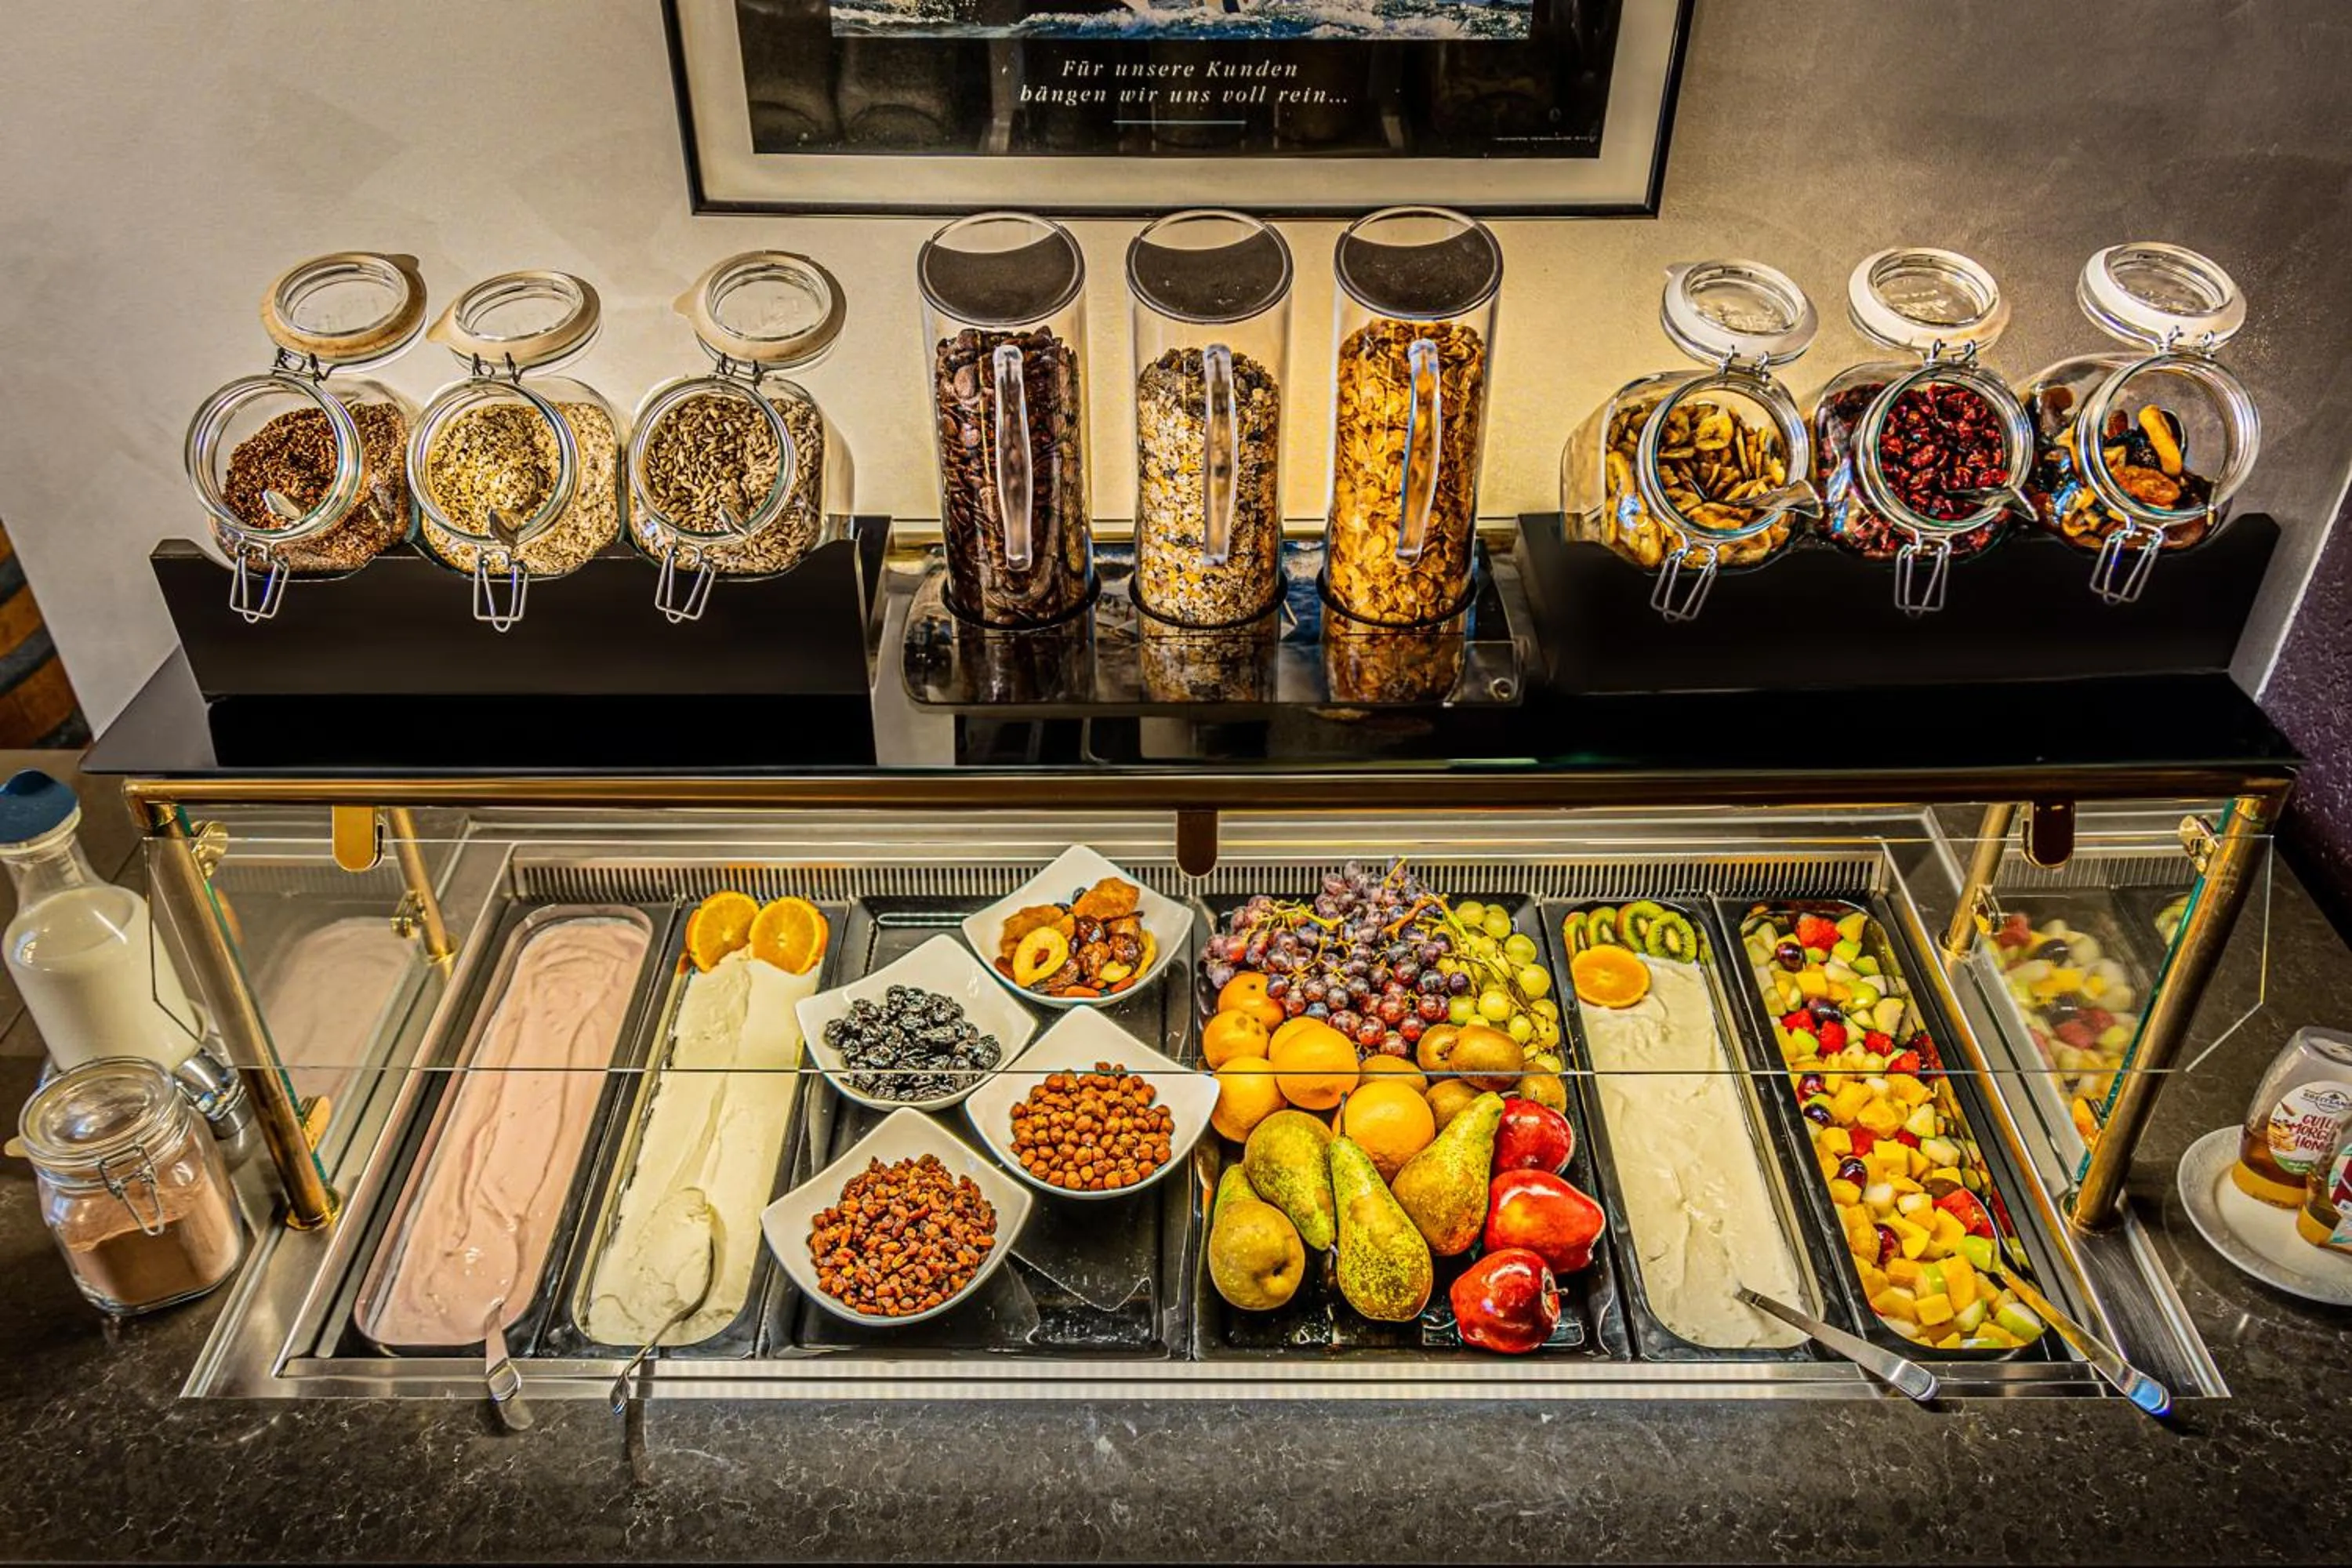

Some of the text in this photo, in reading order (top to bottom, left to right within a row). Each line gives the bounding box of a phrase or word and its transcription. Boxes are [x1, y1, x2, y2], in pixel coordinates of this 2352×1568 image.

[1062, 60, 1298, 77] Für unsere Kunden
[1120, 86, 1159, 103] wir
[1170, 89, 1210, 103] uns
[1221, 85, 1267, 103] voll
